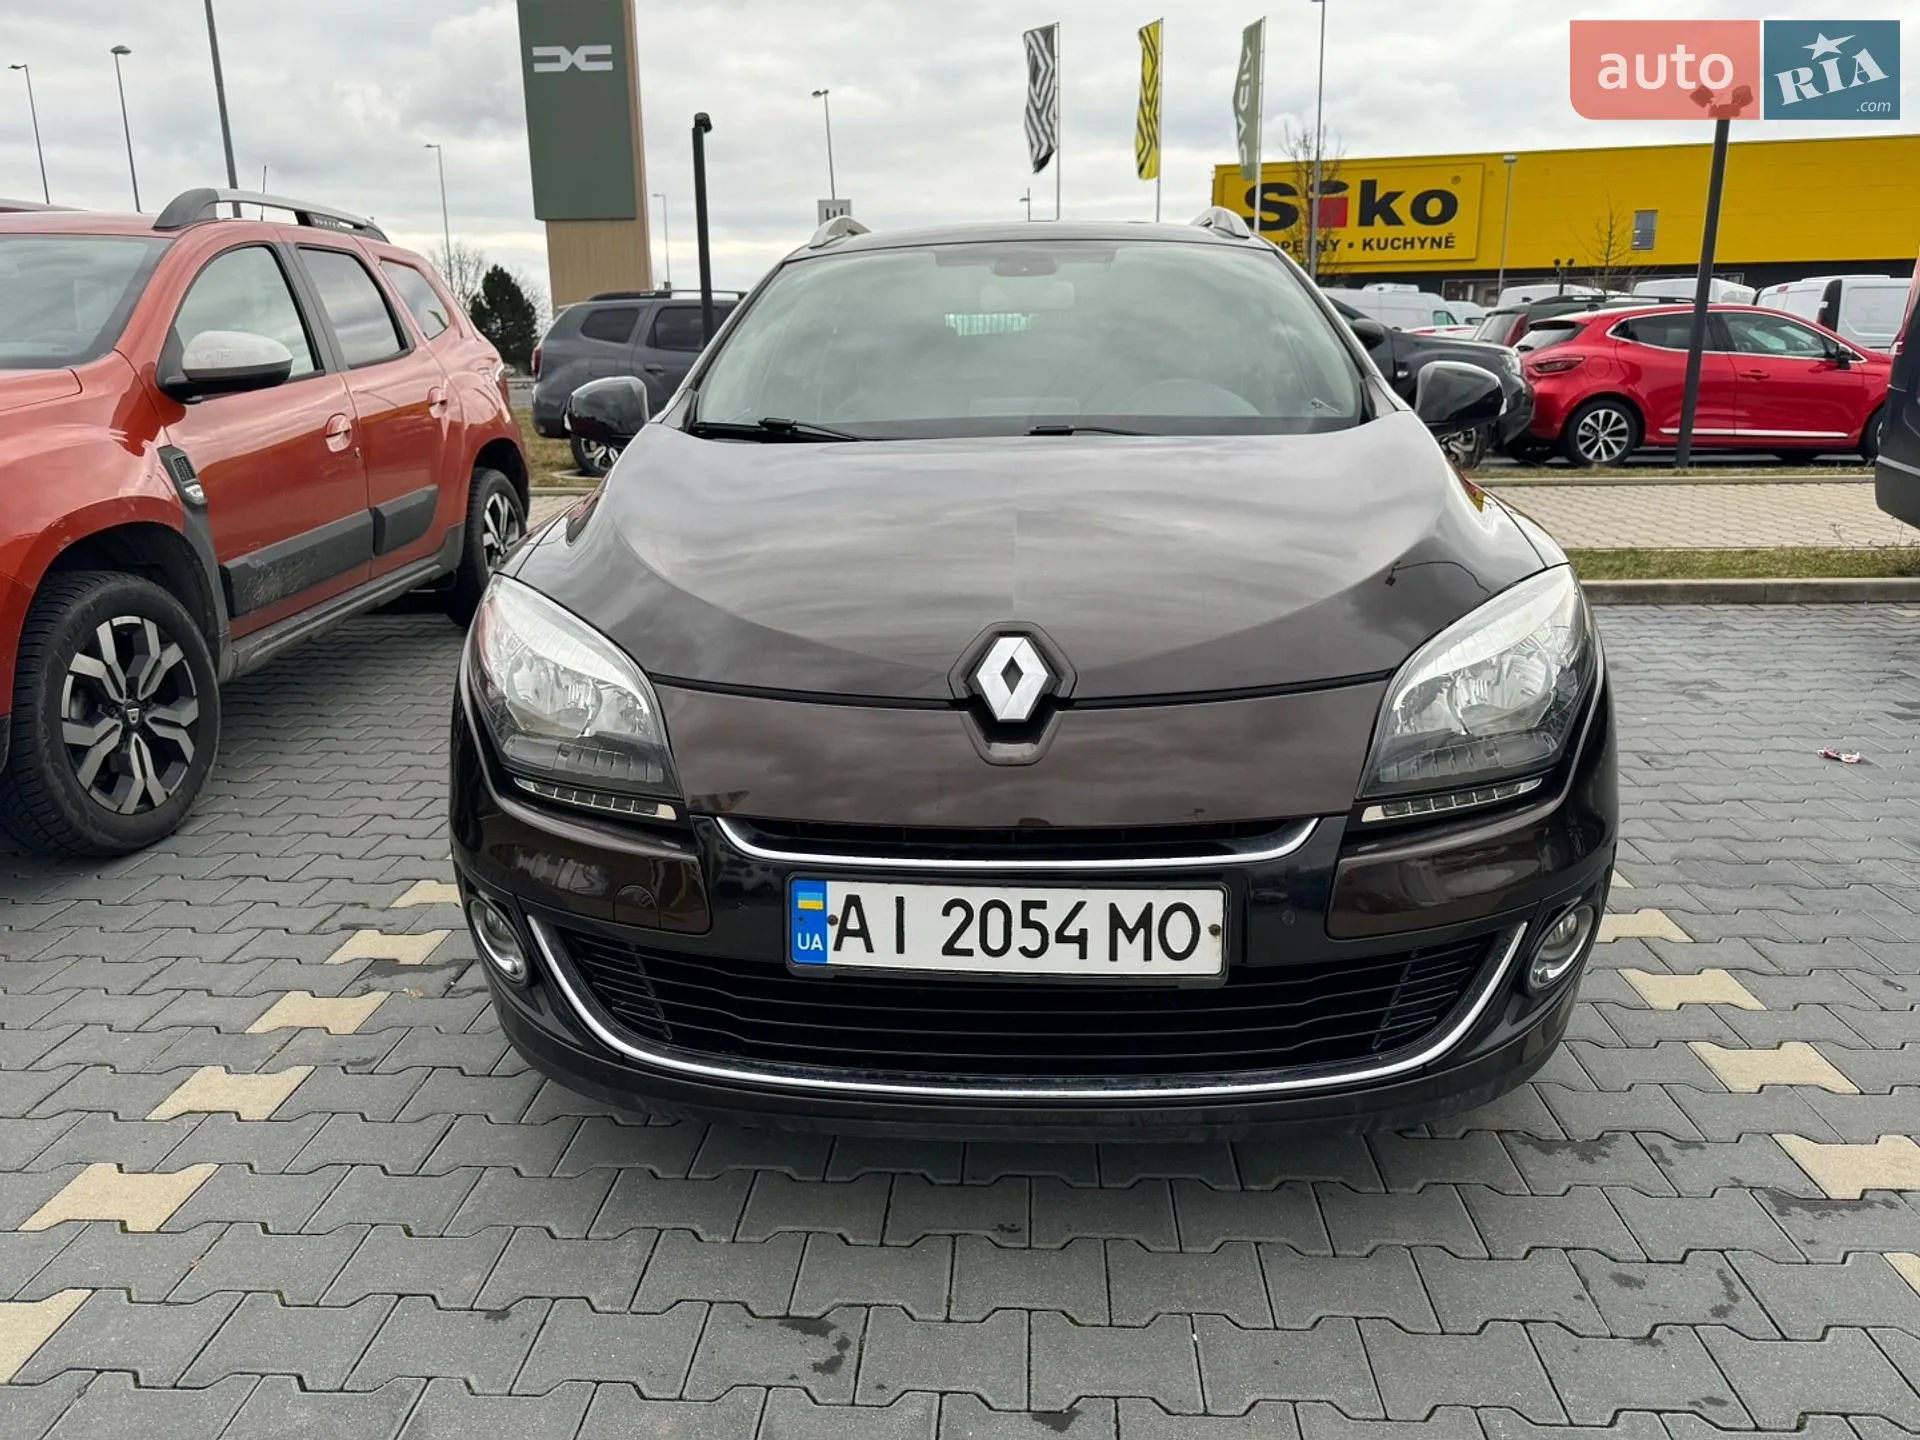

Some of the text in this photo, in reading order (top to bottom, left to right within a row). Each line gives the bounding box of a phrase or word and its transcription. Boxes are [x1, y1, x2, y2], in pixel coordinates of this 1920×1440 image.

[1362, 231, 1456, 251] KUCHYNĚ
[833, 894, 1201, 962] AI 2054 MO
[797, 932, 824, 951] UA
